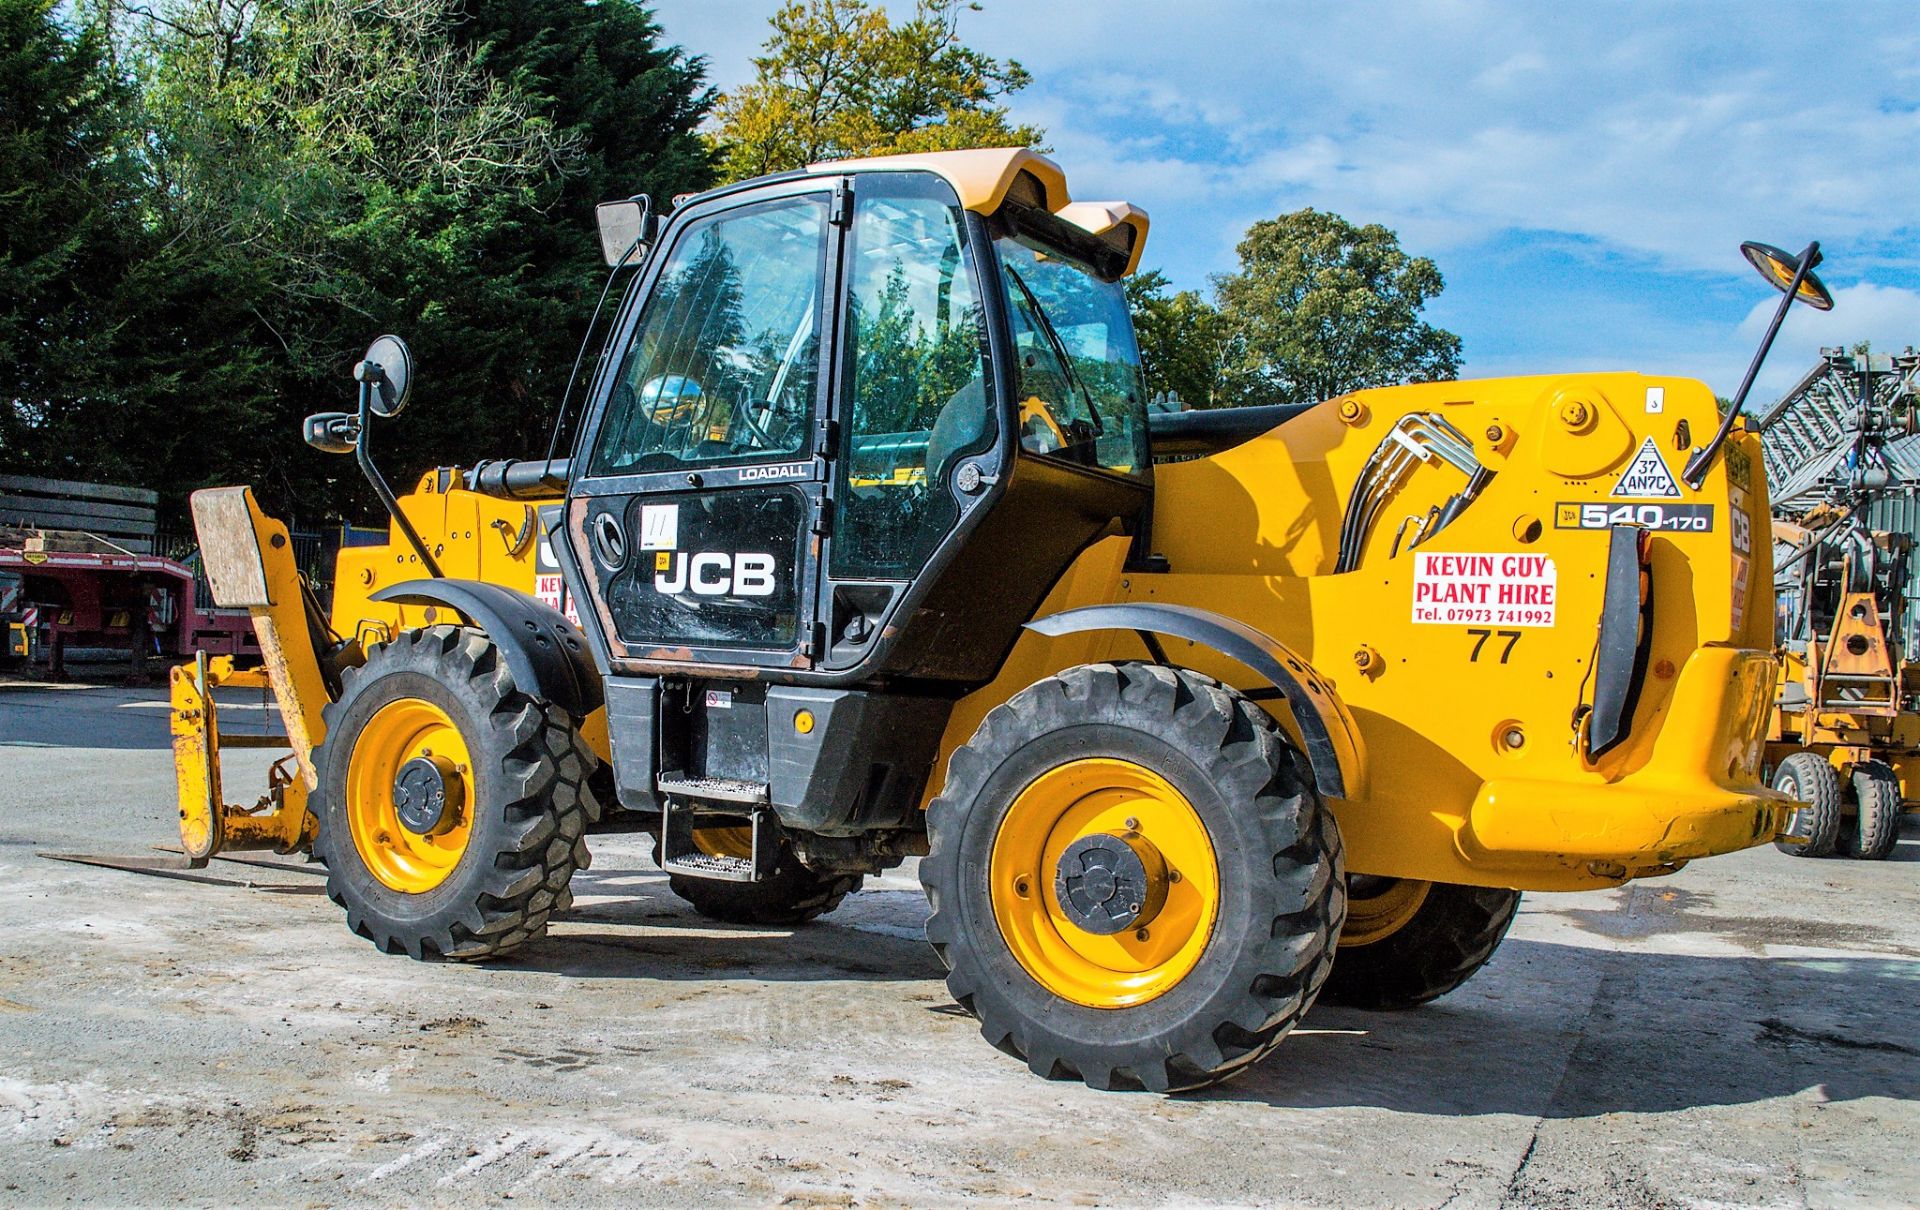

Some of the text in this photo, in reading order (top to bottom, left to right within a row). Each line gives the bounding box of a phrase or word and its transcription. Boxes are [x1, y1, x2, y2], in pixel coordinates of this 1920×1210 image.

[739, 466, 807, 481] LOADALL
[1638, 460, 1657, 474] 37
[1628, 475, 1666, 489] AN7C
[1581, 504, 1707, 530] 540-170
[1732, 507, 1751, 554] CB
[655, 552, 776, 596] JCB
[1426, 555, 1546, 578] KEVIN GUY
[1416, 582, 1554, 605] PLANT HIRE
[1416, 608, 1552, 624] Tel. 07973 741992
[1467, 628, 1522, 665] 77
